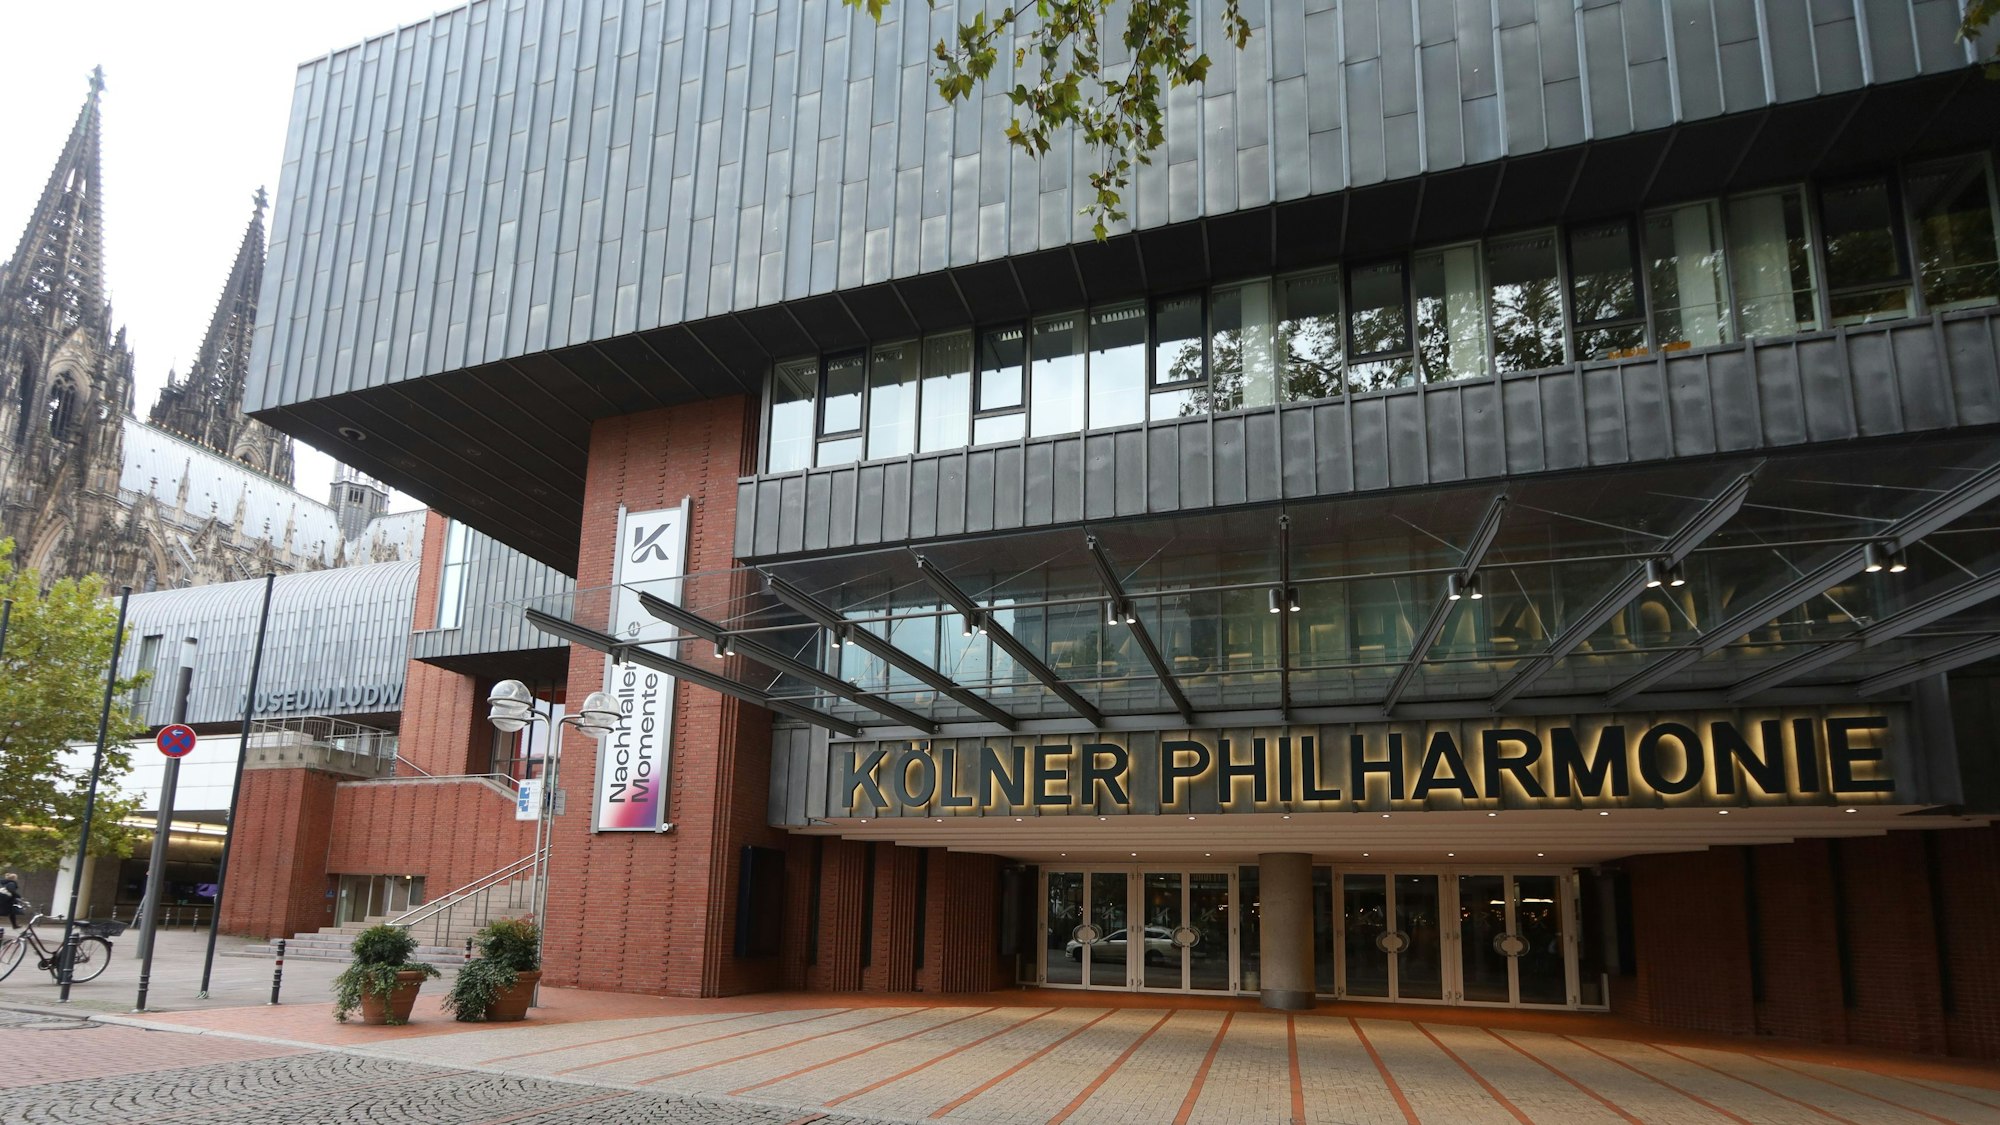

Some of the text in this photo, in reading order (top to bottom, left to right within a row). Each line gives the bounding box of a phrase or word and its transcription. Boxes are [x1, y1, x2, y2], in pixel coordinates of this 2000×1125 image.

[631, 672, 659, 803] Momente
[841, 716, 1896, 808] KÖLNER PHILHARMONIE
